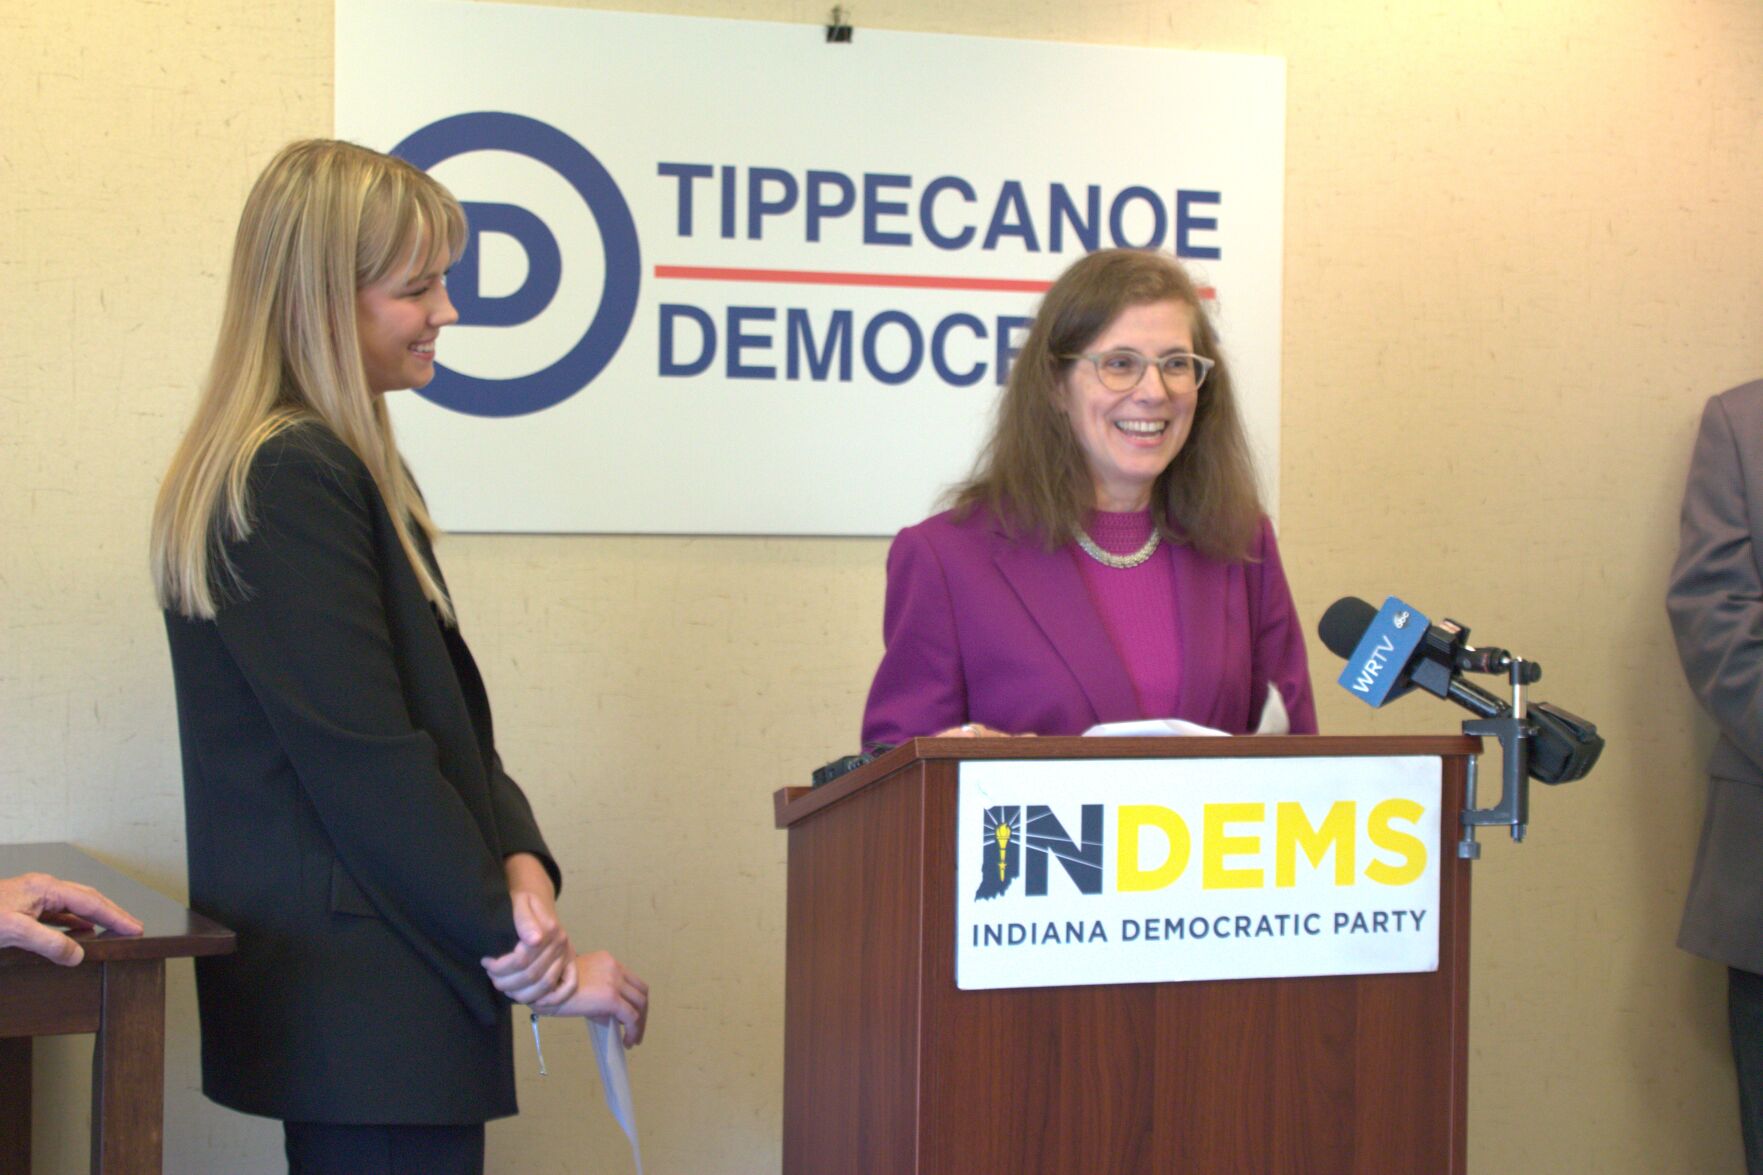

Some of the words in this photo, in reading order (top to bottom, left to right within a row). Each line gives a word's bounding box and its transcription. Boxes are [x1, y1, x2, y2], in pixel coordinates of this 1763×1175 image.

[657, 161, 1222, 260] TIPPECANOE
[1352, 635, 1395, 694] WRTV
[972, 920, 1109, 948] INDIANA
[1121, 912, 1322, 942] DEMOCRATIC
[1333, 909, 1428, 935] PARTY
